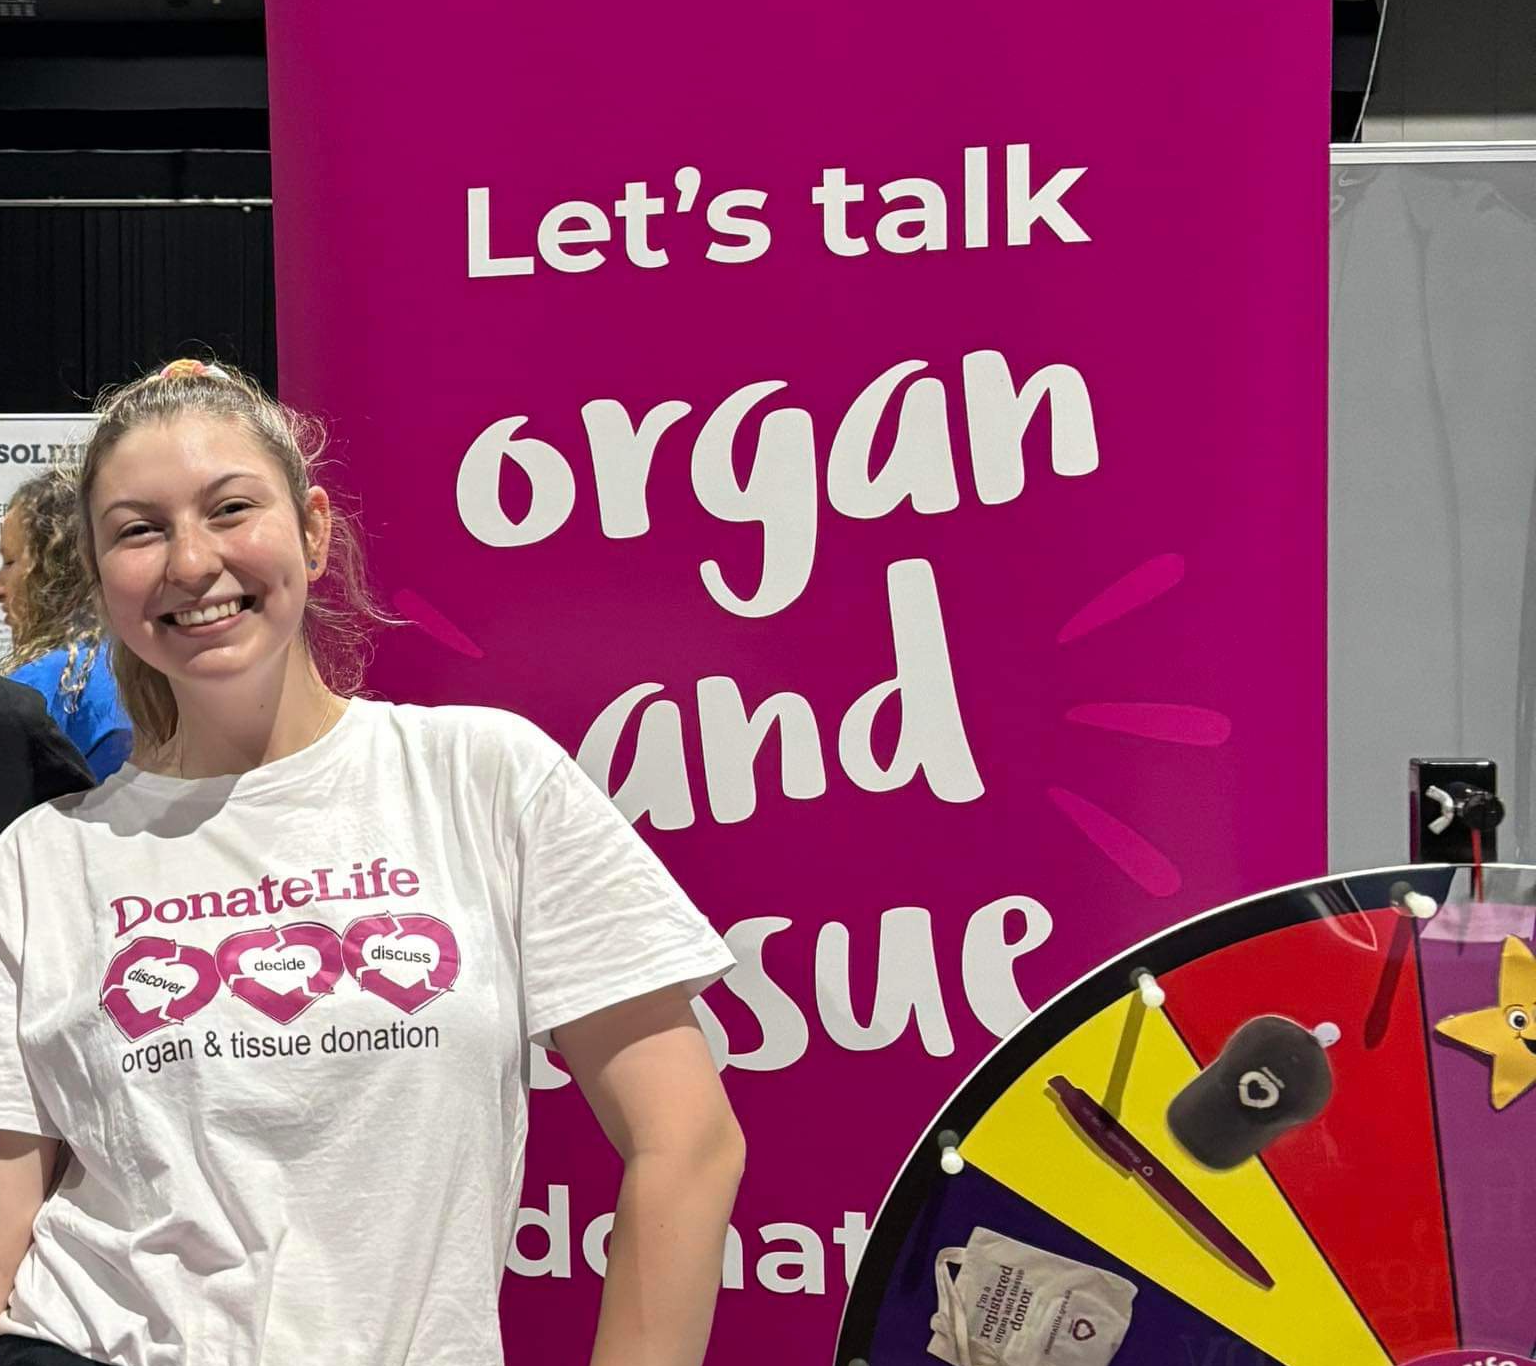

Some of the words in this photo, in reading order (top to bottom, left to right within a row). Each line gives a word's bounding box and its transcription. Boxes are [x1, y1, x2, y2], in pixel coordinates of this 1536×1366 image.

[811, 143, 1093, 258] talk
[455, 349, 1100, 618] organ
[576, 557, 986, 831] and
[109, 857, 421, 939] DonateLife
[127, 968, 188, 996] discover
[253, 957, 307, 973] decide
[369, 945, 433, 965] discuss
[120, 1038, 195, 1075] organ
[203, 1032, 223, 1059] &
[230, 1030, 312, 1060] tissue
[320, 1021, 440, 1054] donation
[980, 1264, 1014, 1340] registered
[1011, 1287, 1034, 1332] donor
